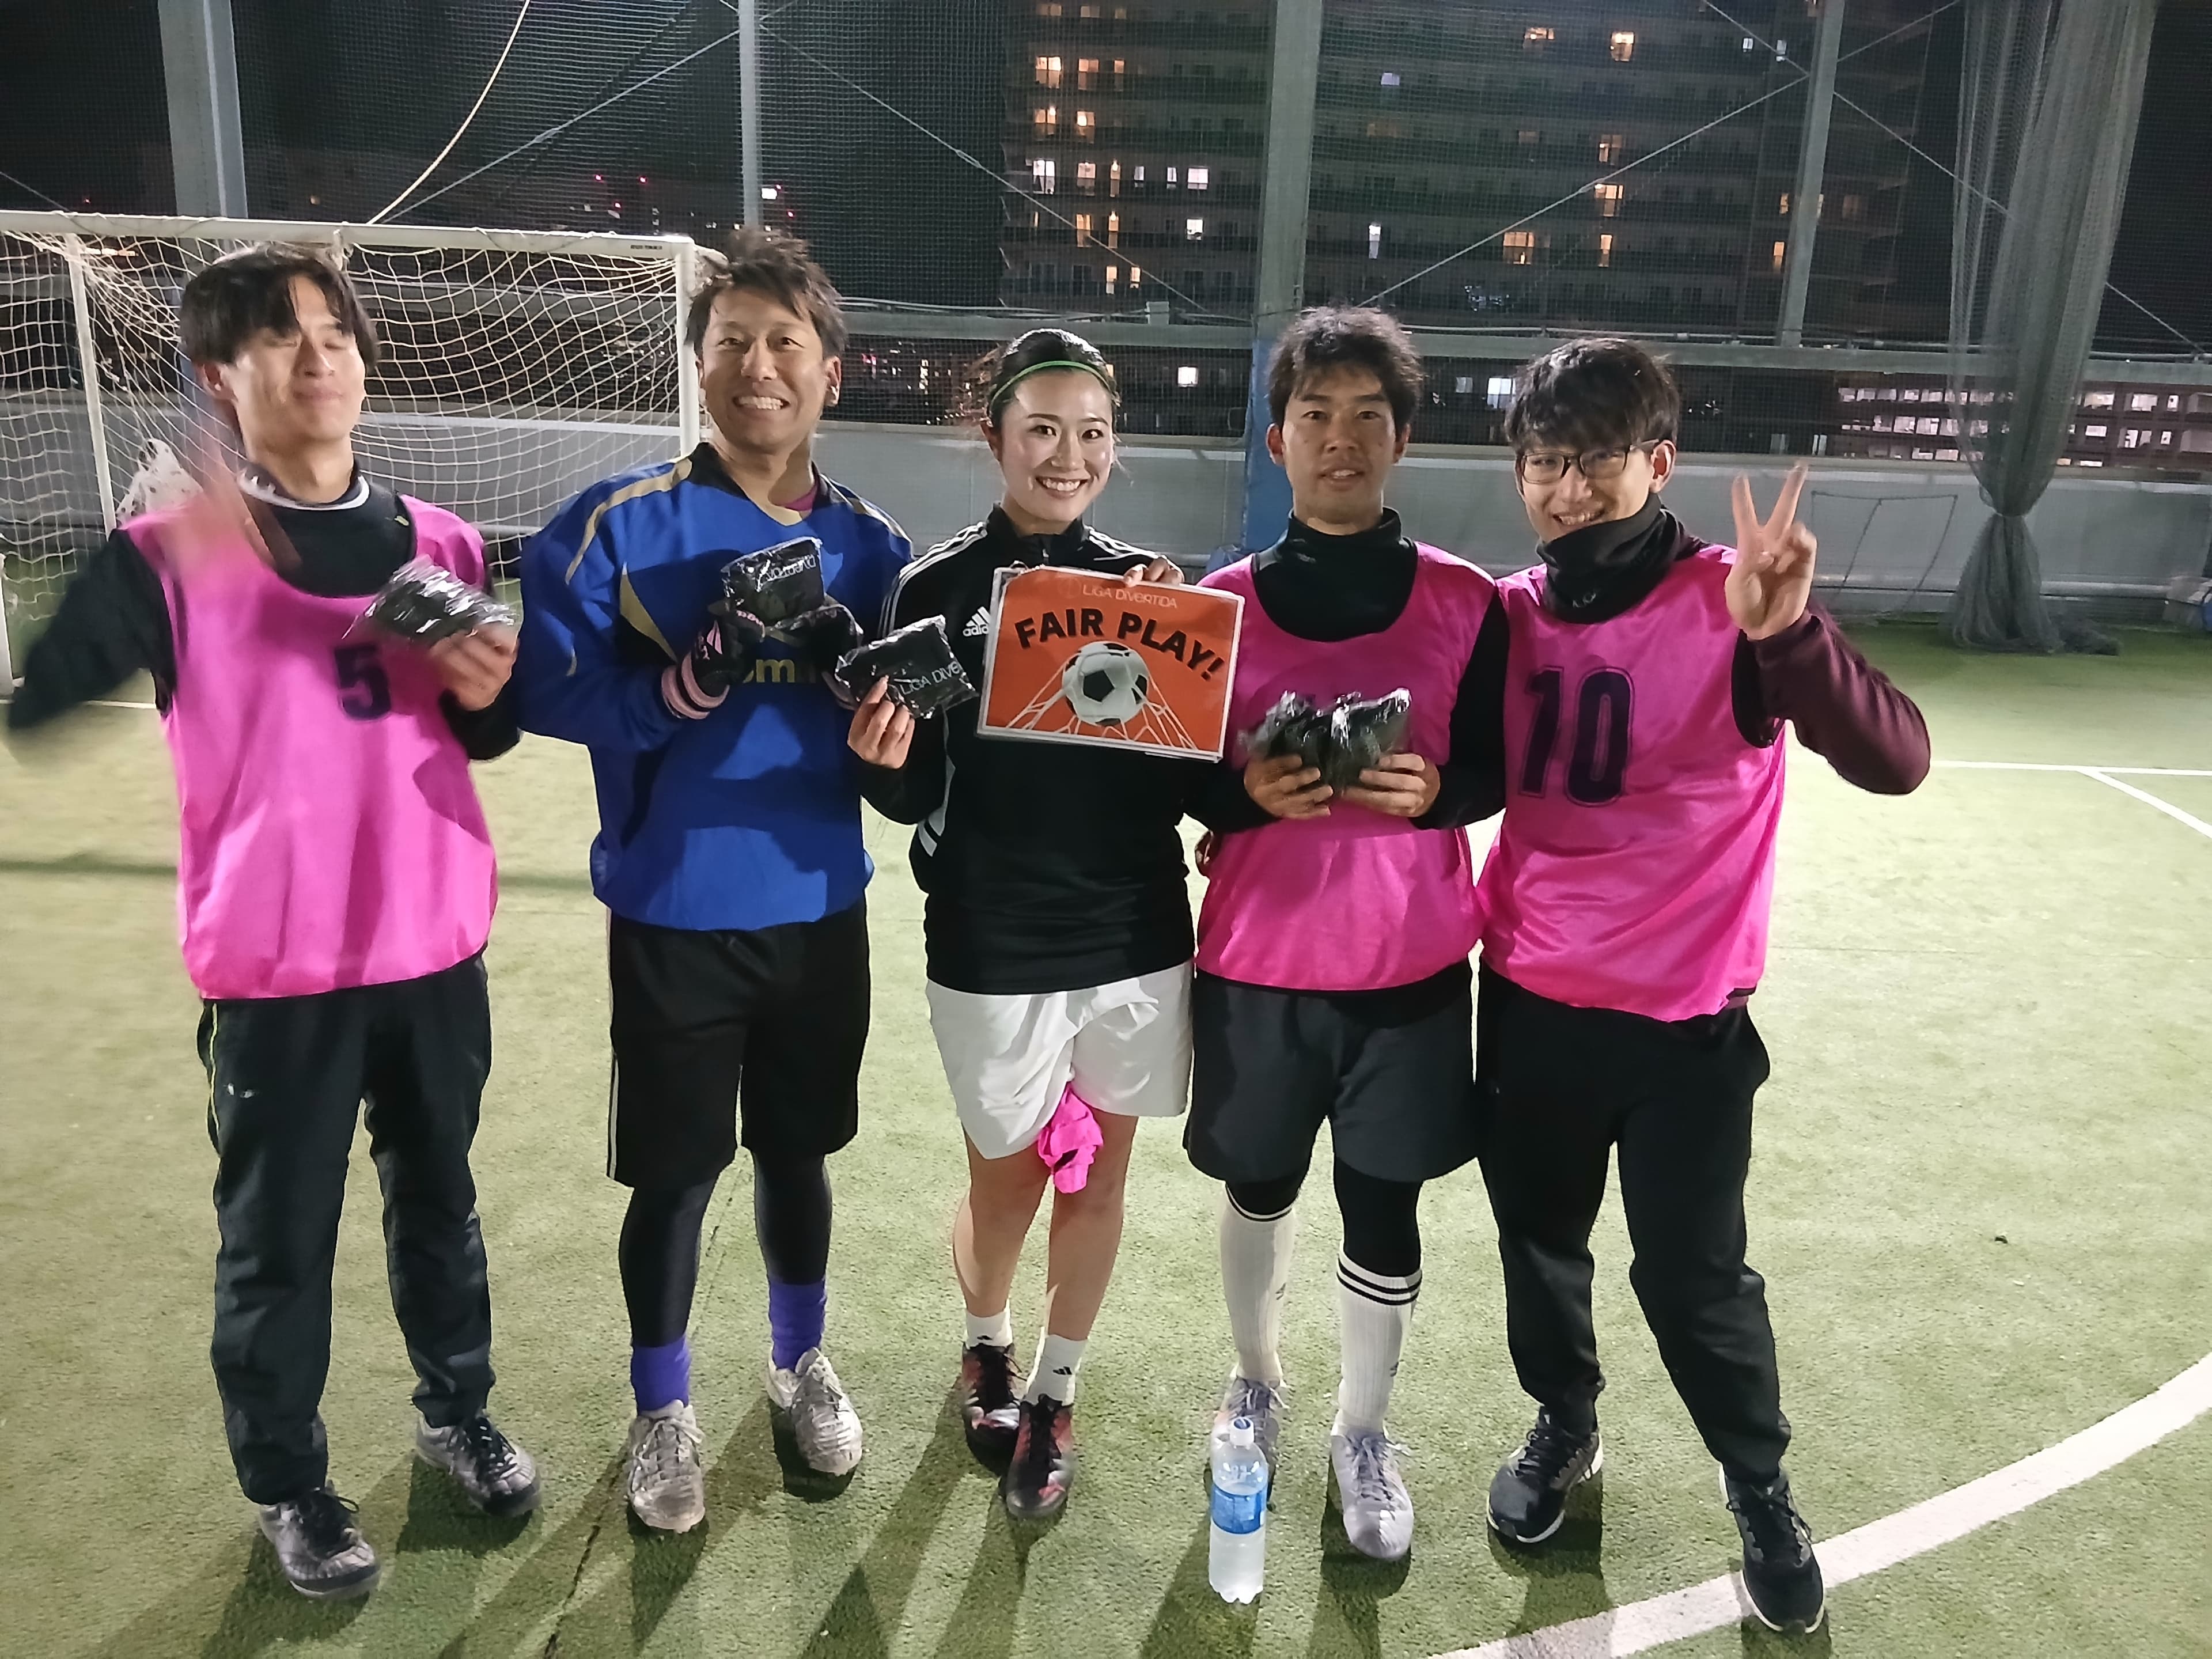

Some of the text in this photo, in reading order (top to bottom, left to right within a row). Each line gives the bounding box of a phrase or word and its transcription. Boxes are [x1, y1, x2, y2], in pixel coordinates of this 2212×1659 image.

[1082, 584, 1112, 599] LIGA
[1014, 607, 1225, 682] FAIR PLAY!
[334, 643, 392, 723] 5
[900, 675, 931, 695] LIGA
[1518, 665, 1635, 808] 10
